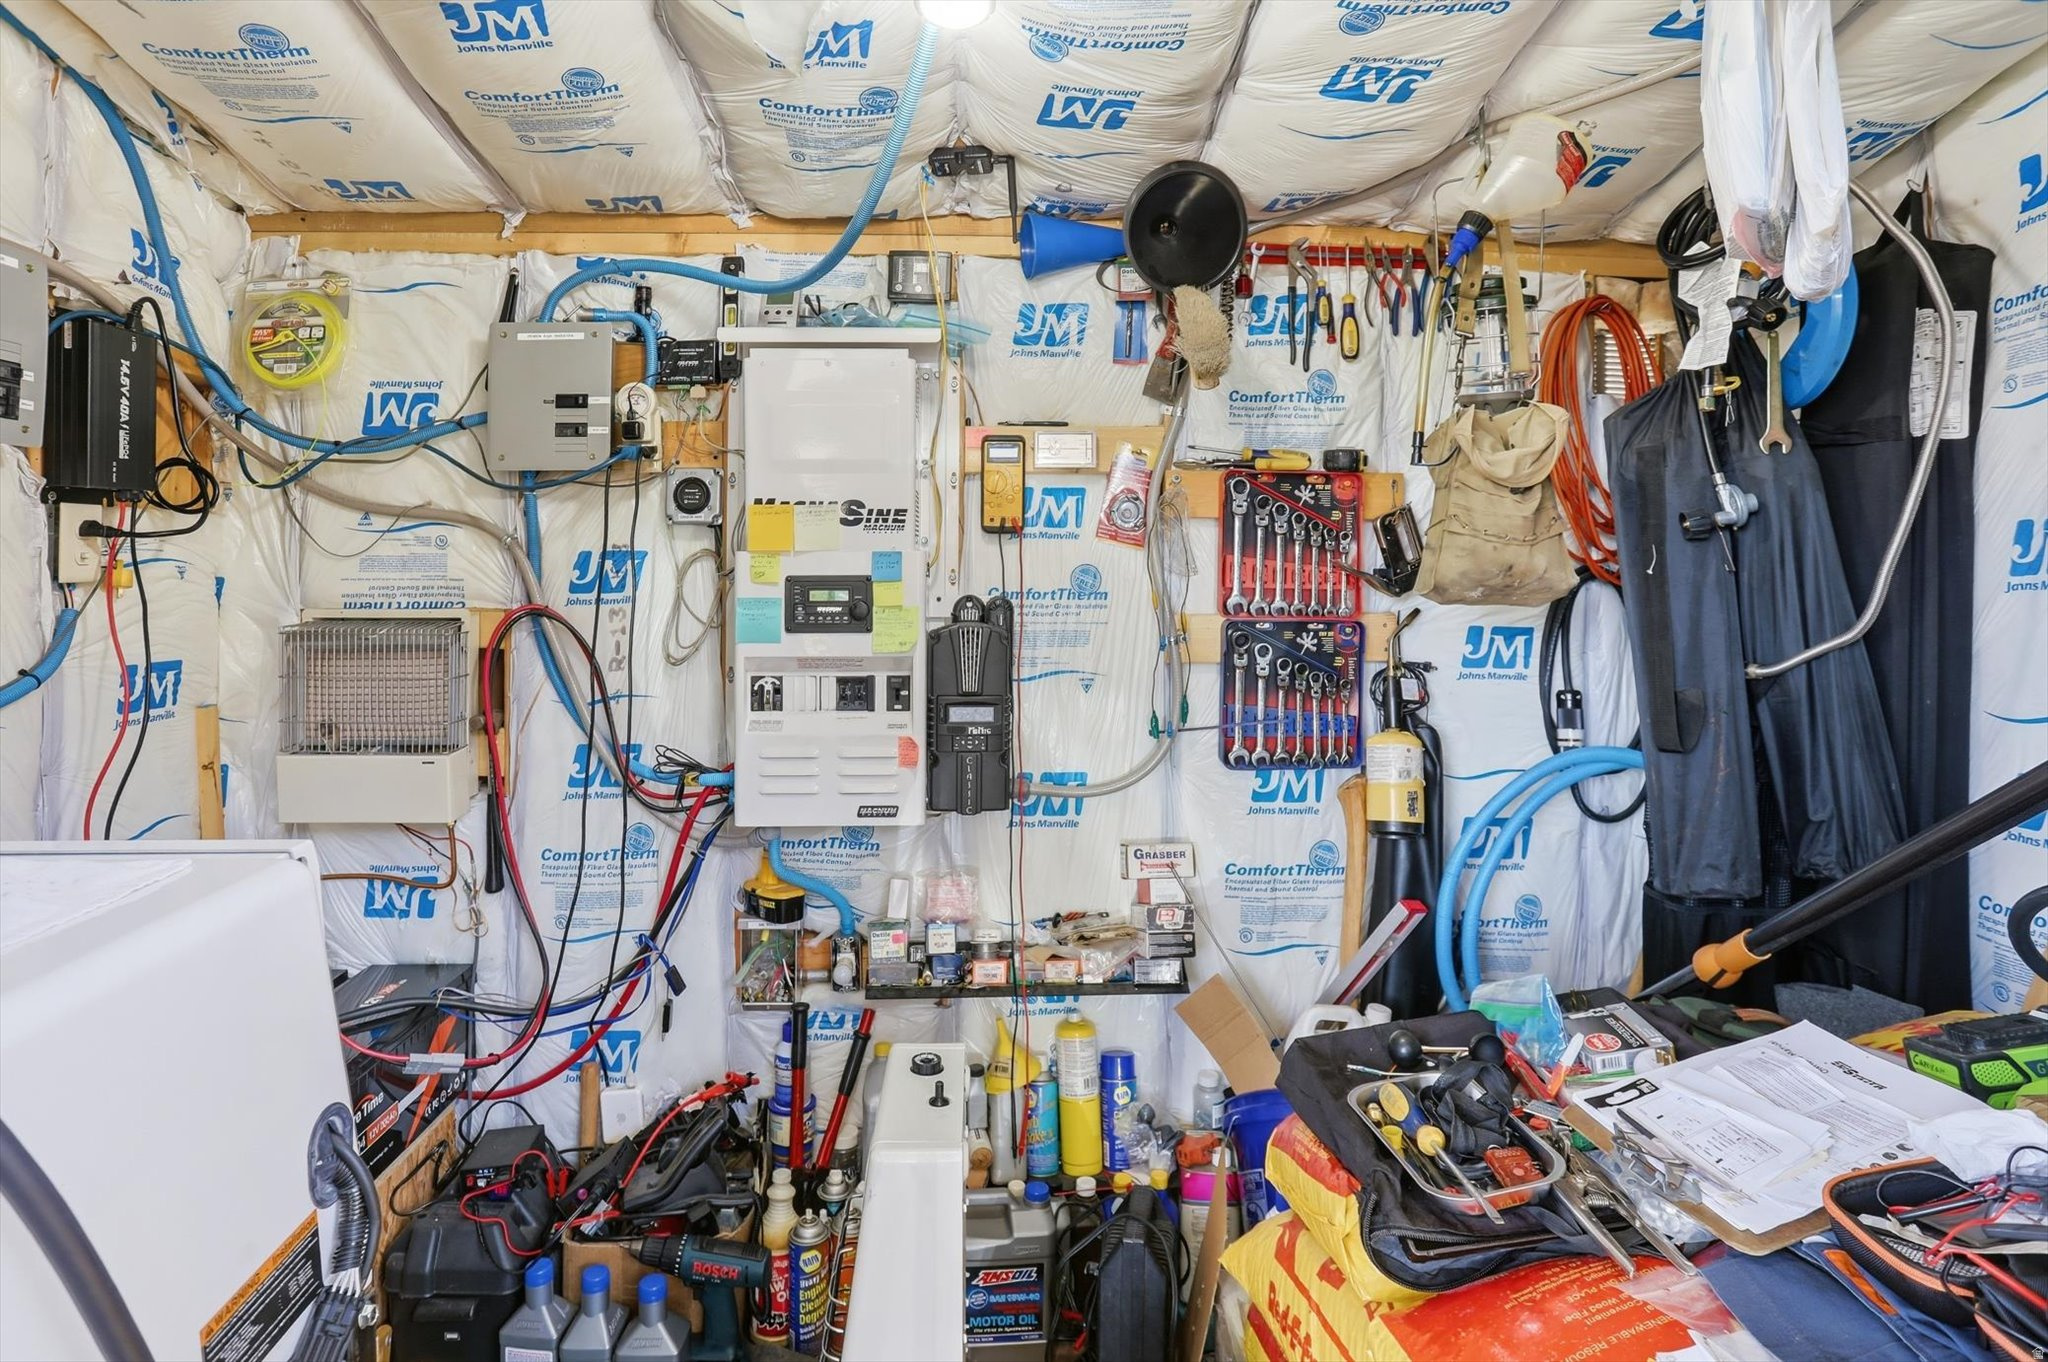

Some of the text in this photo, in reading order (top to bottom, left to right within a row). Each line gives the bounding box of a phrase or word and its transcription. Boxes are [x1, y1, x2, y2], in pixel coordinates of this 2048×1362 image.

[142, 43, 310, 60] ComfortTherm
[465, 83, 619, 103] ComfortTherm
[370, 379, 411, 389] Manville
[1228, 391, 1345, 405] ComfortTherm
[1461, 625, 1534, 669] JM
[1246, 806, 1319, 816] Johns Manville
[1133, 848, 1186, 861] GRASBER
[1225, 863, 1345, 876] ComfortTherm
[692, 1260, 740, 1281] BOSCH
[971, 1268, 1038, 1287] AMSOIL
[970, 1314, 1038, 1328] MOTOR OIL
